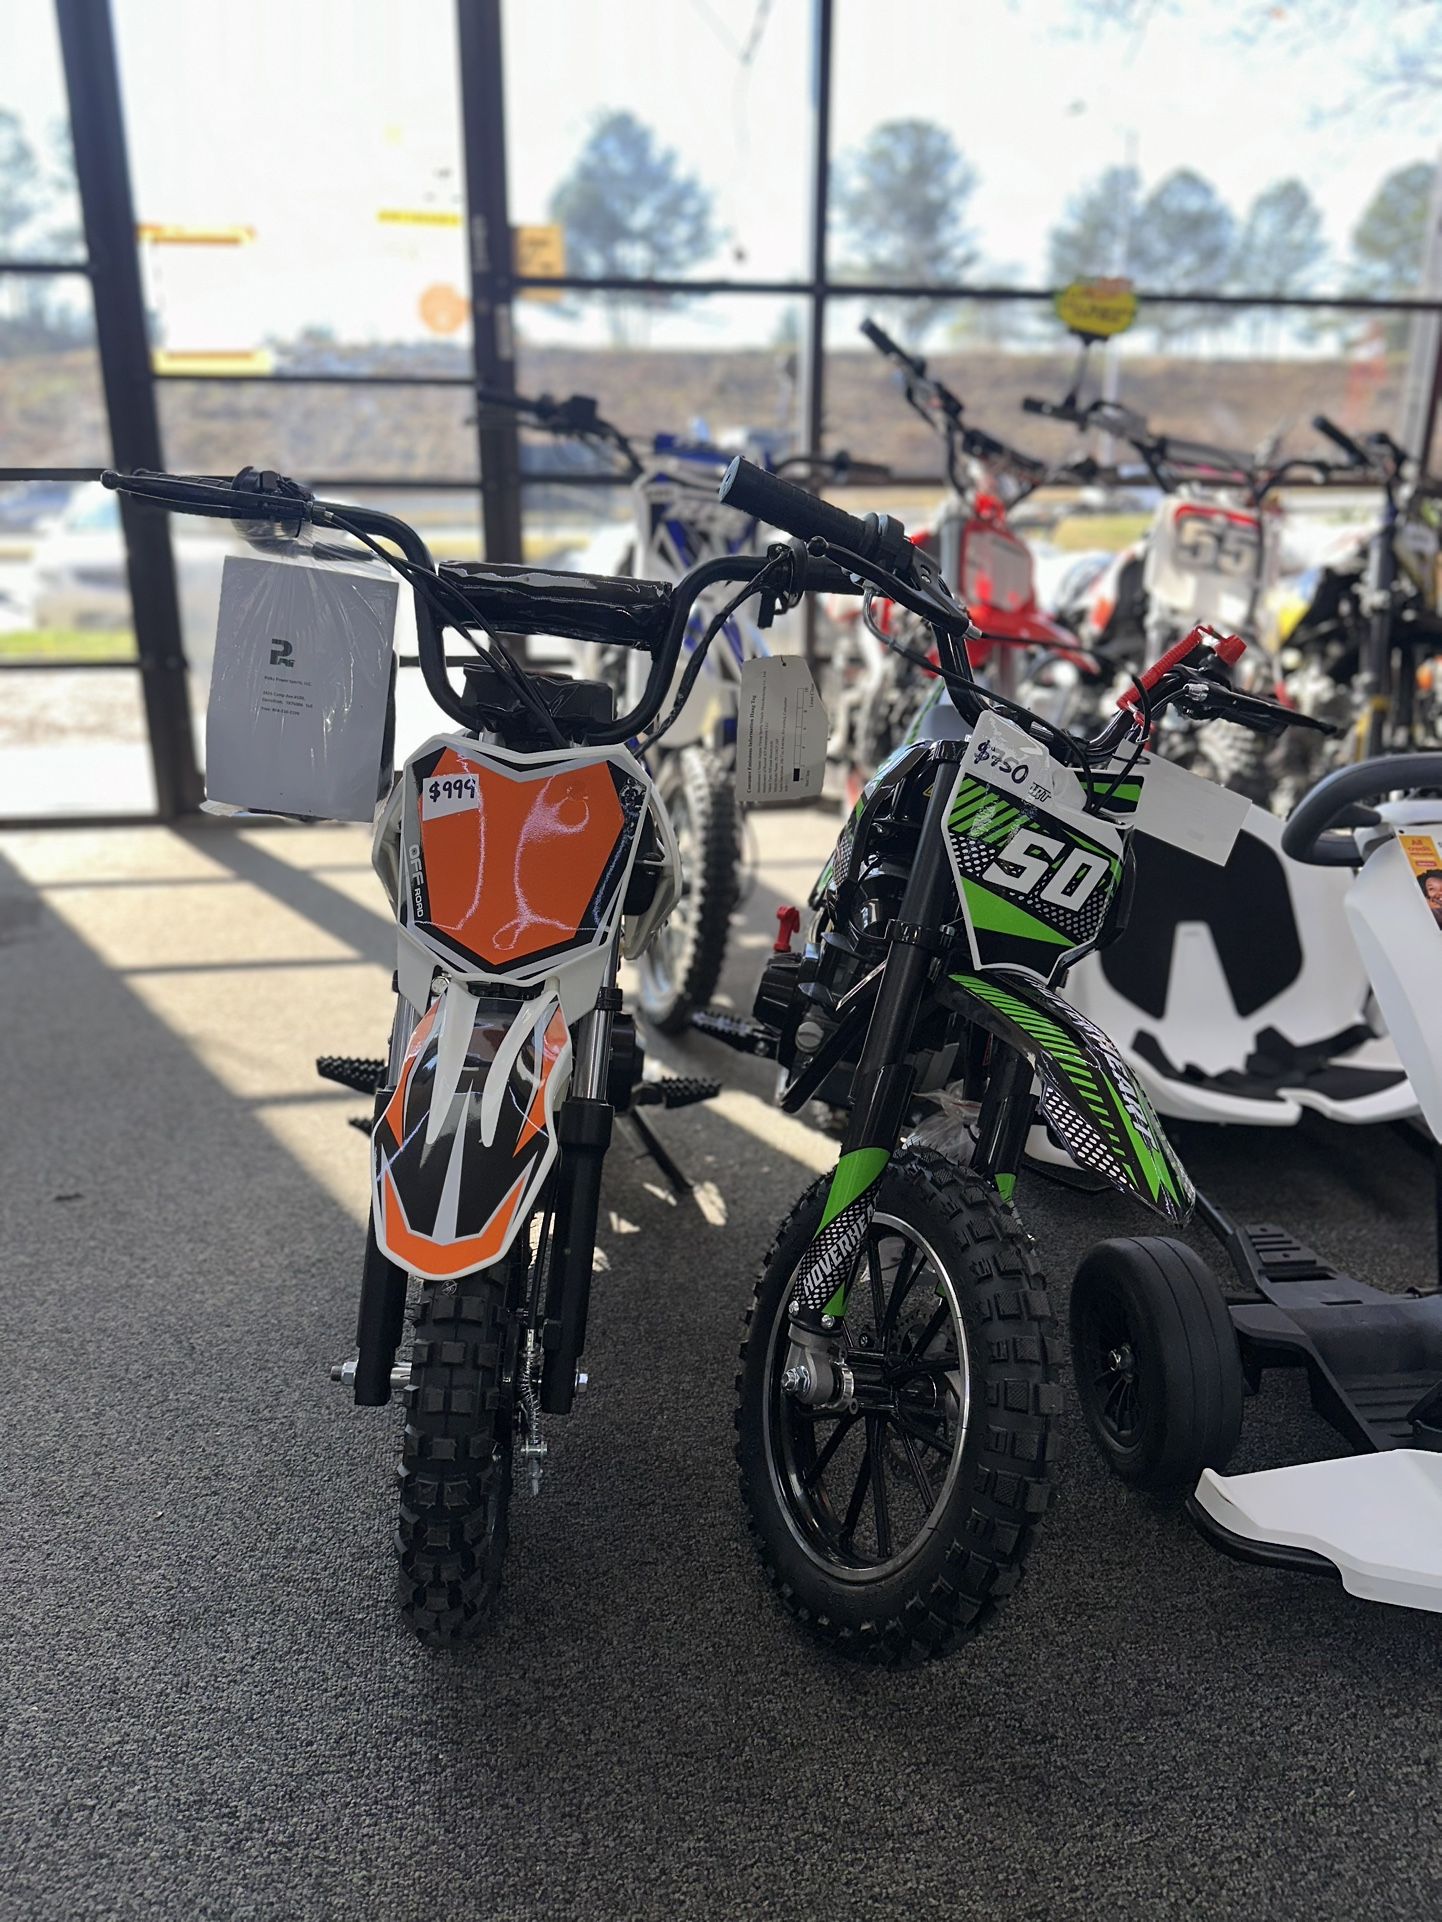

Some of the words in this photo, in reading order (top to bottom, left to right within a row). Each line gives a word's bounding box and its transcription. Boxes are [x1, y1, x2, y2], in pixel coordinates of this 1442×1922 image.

[974, 740, 1029, 784] $750
[429, 779, 476, 802] $999
[409, 844, 424, 885] OFF
[982, 828, 1111, 912] 50
[414, 887, 424, 917] ROAD
